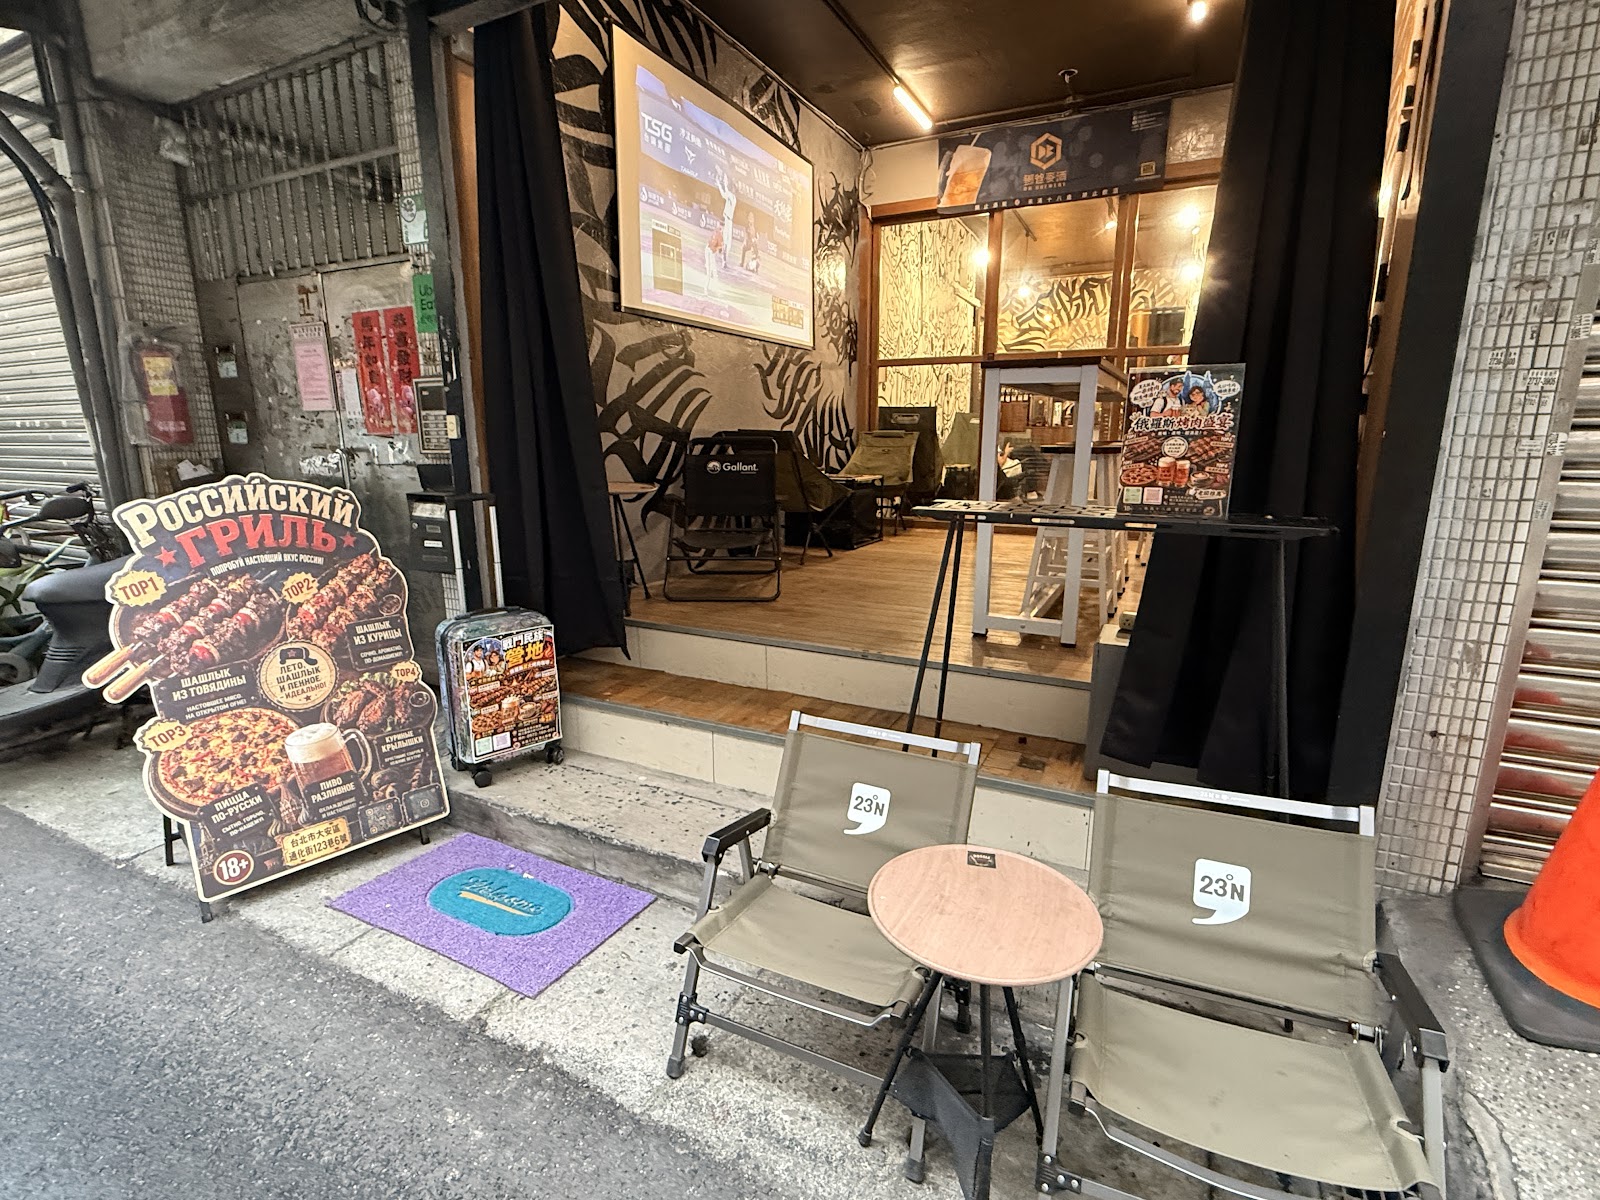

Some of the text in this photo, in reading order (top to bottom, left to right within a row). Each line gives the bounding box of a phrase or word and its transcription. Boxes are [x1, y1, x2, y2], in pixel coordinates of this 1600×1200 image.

[640, 112, 672, 144] TSG
[121, 480, 355, 549] РОССИЙСКИЙ
[175, 514, 338, 568] ГРИЛЬ
[210, 557, 244, 576] ПОПРОБУЙ
[244, 552, 282, 565] НАСТОЯЩИЙ
[284, 554, 298, 562] ВКУС
[119, 576, 160, 598] TOP1
[353, 628, 402, 646] ИЗ КУРИЦЫ
[356, 620, 392, 634] ШАШЛЫК
[506, 642, 544, 667] 營地
[180, 668, 231, 688] ШАШЛЫК
[276, 666, 321, 684] ШАШЛЫК
[395, 667, 416, 678] TOP4
[280, 675, 321, 692] И ПЕННОЕ
[172, 689, 188, 701] ИЗ
[185, 712, 195, 720] НА
[148, 726, 186, 748] TOP3
[385, 730, 414, 743] КУРИНЫЕ
[311, 782, 356, 803] РАЗЛИВНОЕ
[320, 777, 342, 790] ПИВО
[211, 794, 263, 824] ПО-РУССКИ
[214, 791, 250, 812] ПИЦЦА
[290, 824, 340, 848] 台北市大安區
[288, 834, 348, 862] 通化街123巷6號
[218, 857, 250, 880] 18+
